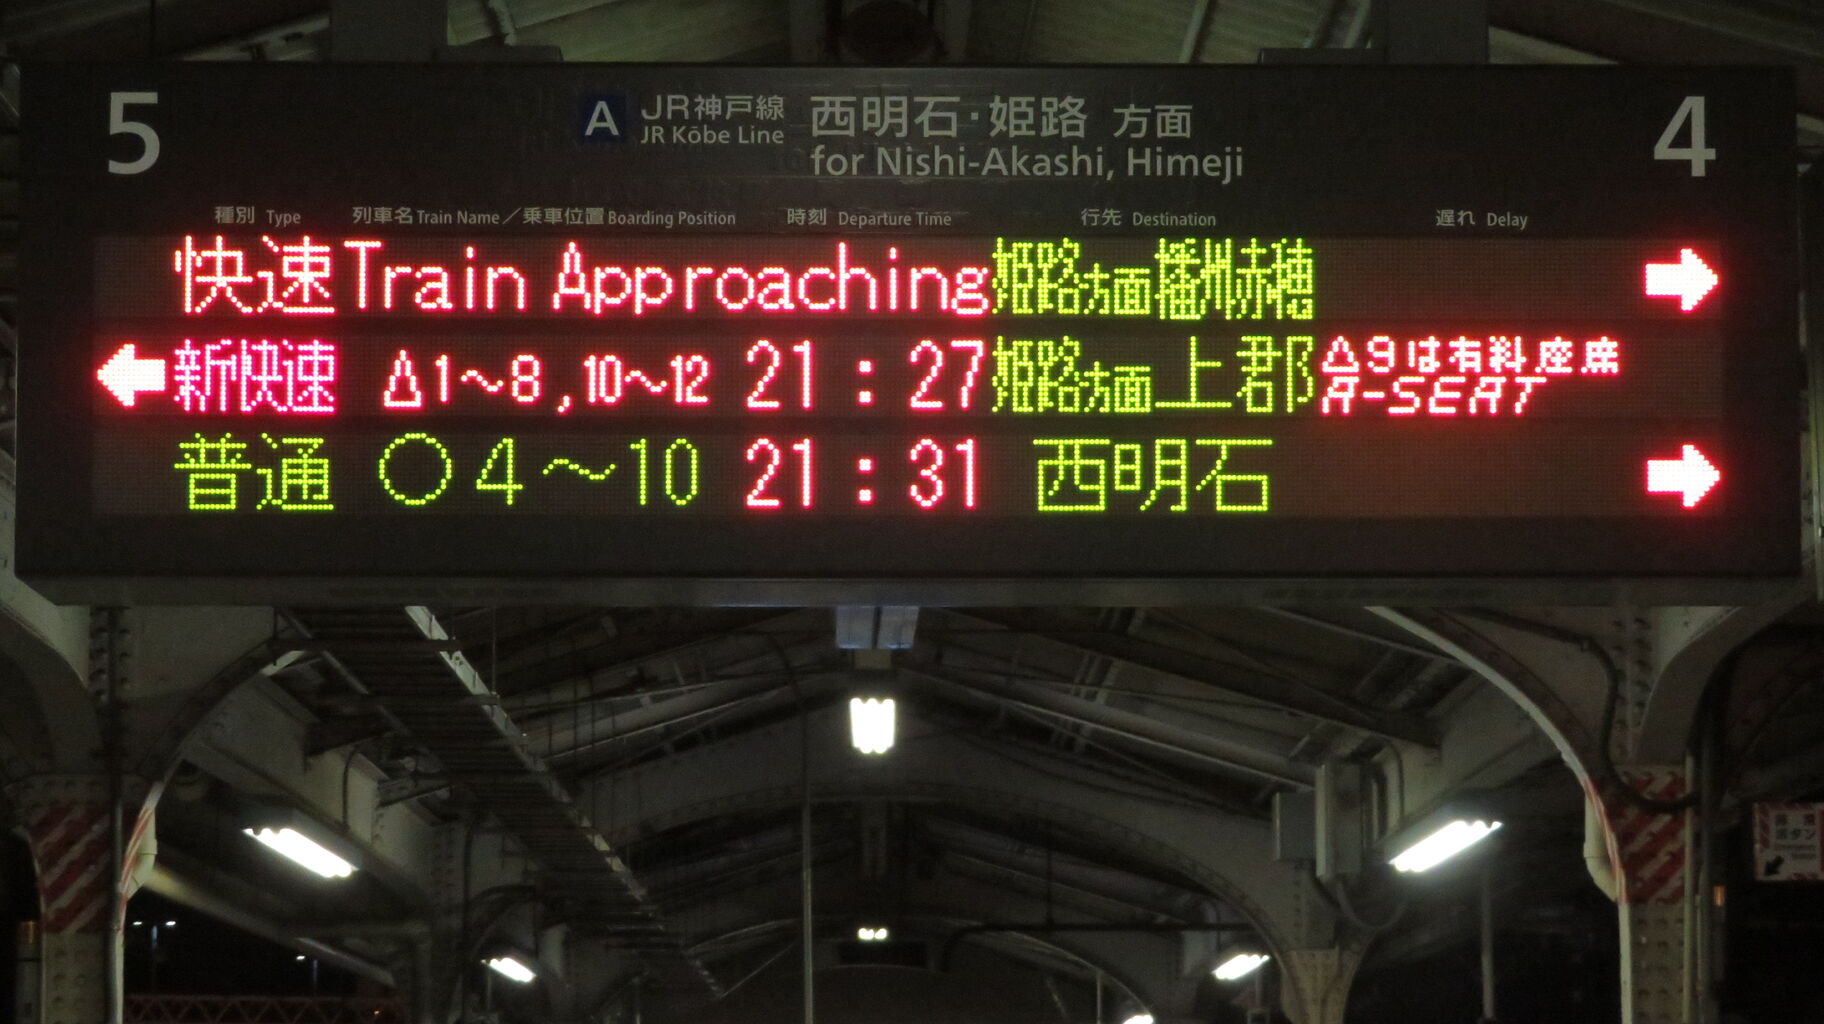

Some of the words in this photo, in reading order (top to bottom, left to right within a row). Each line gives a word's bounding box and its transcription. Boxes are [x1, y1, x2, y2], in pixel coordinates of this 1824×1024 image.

[584, 100, 620, 136] A
[641, 93, 785, 121] JR神戸線
[1113, 103, 1193, 139] 方面
[108, 91, 161, 175] 5
[640, 125, 665, 145] JR
[672, 123, 731, 145] Kōbe
[738, 124, 785, 145] Line
[1653, 95, 1717, 177] 4
[810, 144, 864, 176] for
[876, 145, 1114, 183] Nishi-Akashi,
[1127, 146, 1243, 185] Himeji
[215, 206, 255, 224] 種別
[266, 209, 301, 228] Type
[352, 206, 413, 225] 列車名
[416, 209, 453, 224] Train
[457, 210, 500, 225] Name
[522, 206, 605, 225] 乗車位置
[608, 210, 674, 229] Boarding
[678, 210, 736, 225] Position
[785, 207, 828, 226] 時刻
[838, 210, 912, 230] Departure
[915, 210, 952, 226] Time
[1080, 207, 1122, 227] 行先
[1132, 211, 1217, 227] Destination
[1435, 209, 1476, 227] 遅れ
[1487, 211, 1528, 231] Delay
[175, 235, 335, 314] 快速
[343, 240, 525, 310] Train
[553, 241, 989, 315] Approaching
[174, 339, 335, 412] 新快速
[174, 432, 335, 511] 普通
[1032, 438, 1274, 512] 西明石
